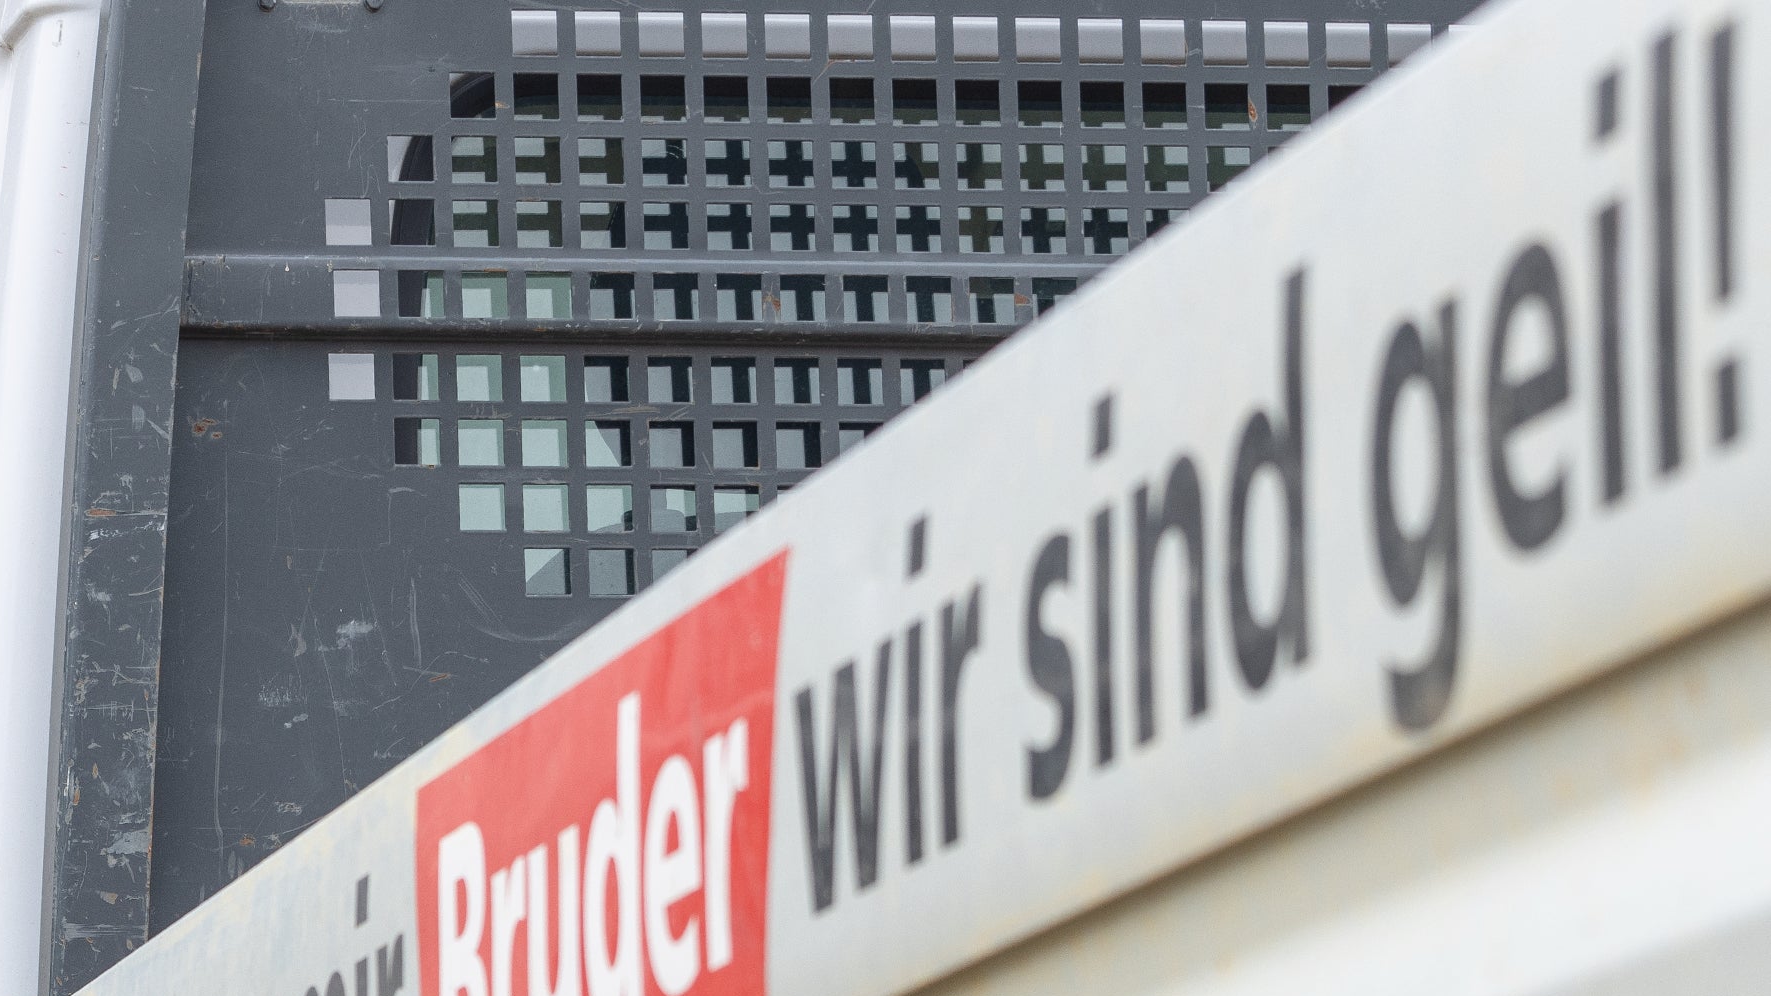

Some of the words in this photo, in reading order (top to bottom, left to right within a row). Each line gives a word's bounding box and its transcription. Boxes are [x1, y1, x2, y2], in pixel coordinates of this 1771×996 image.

[793, 513, 984, 916] wir
[1021, 256, 1314, 804] sind
[1367, 17, 1749, 735] geil!
